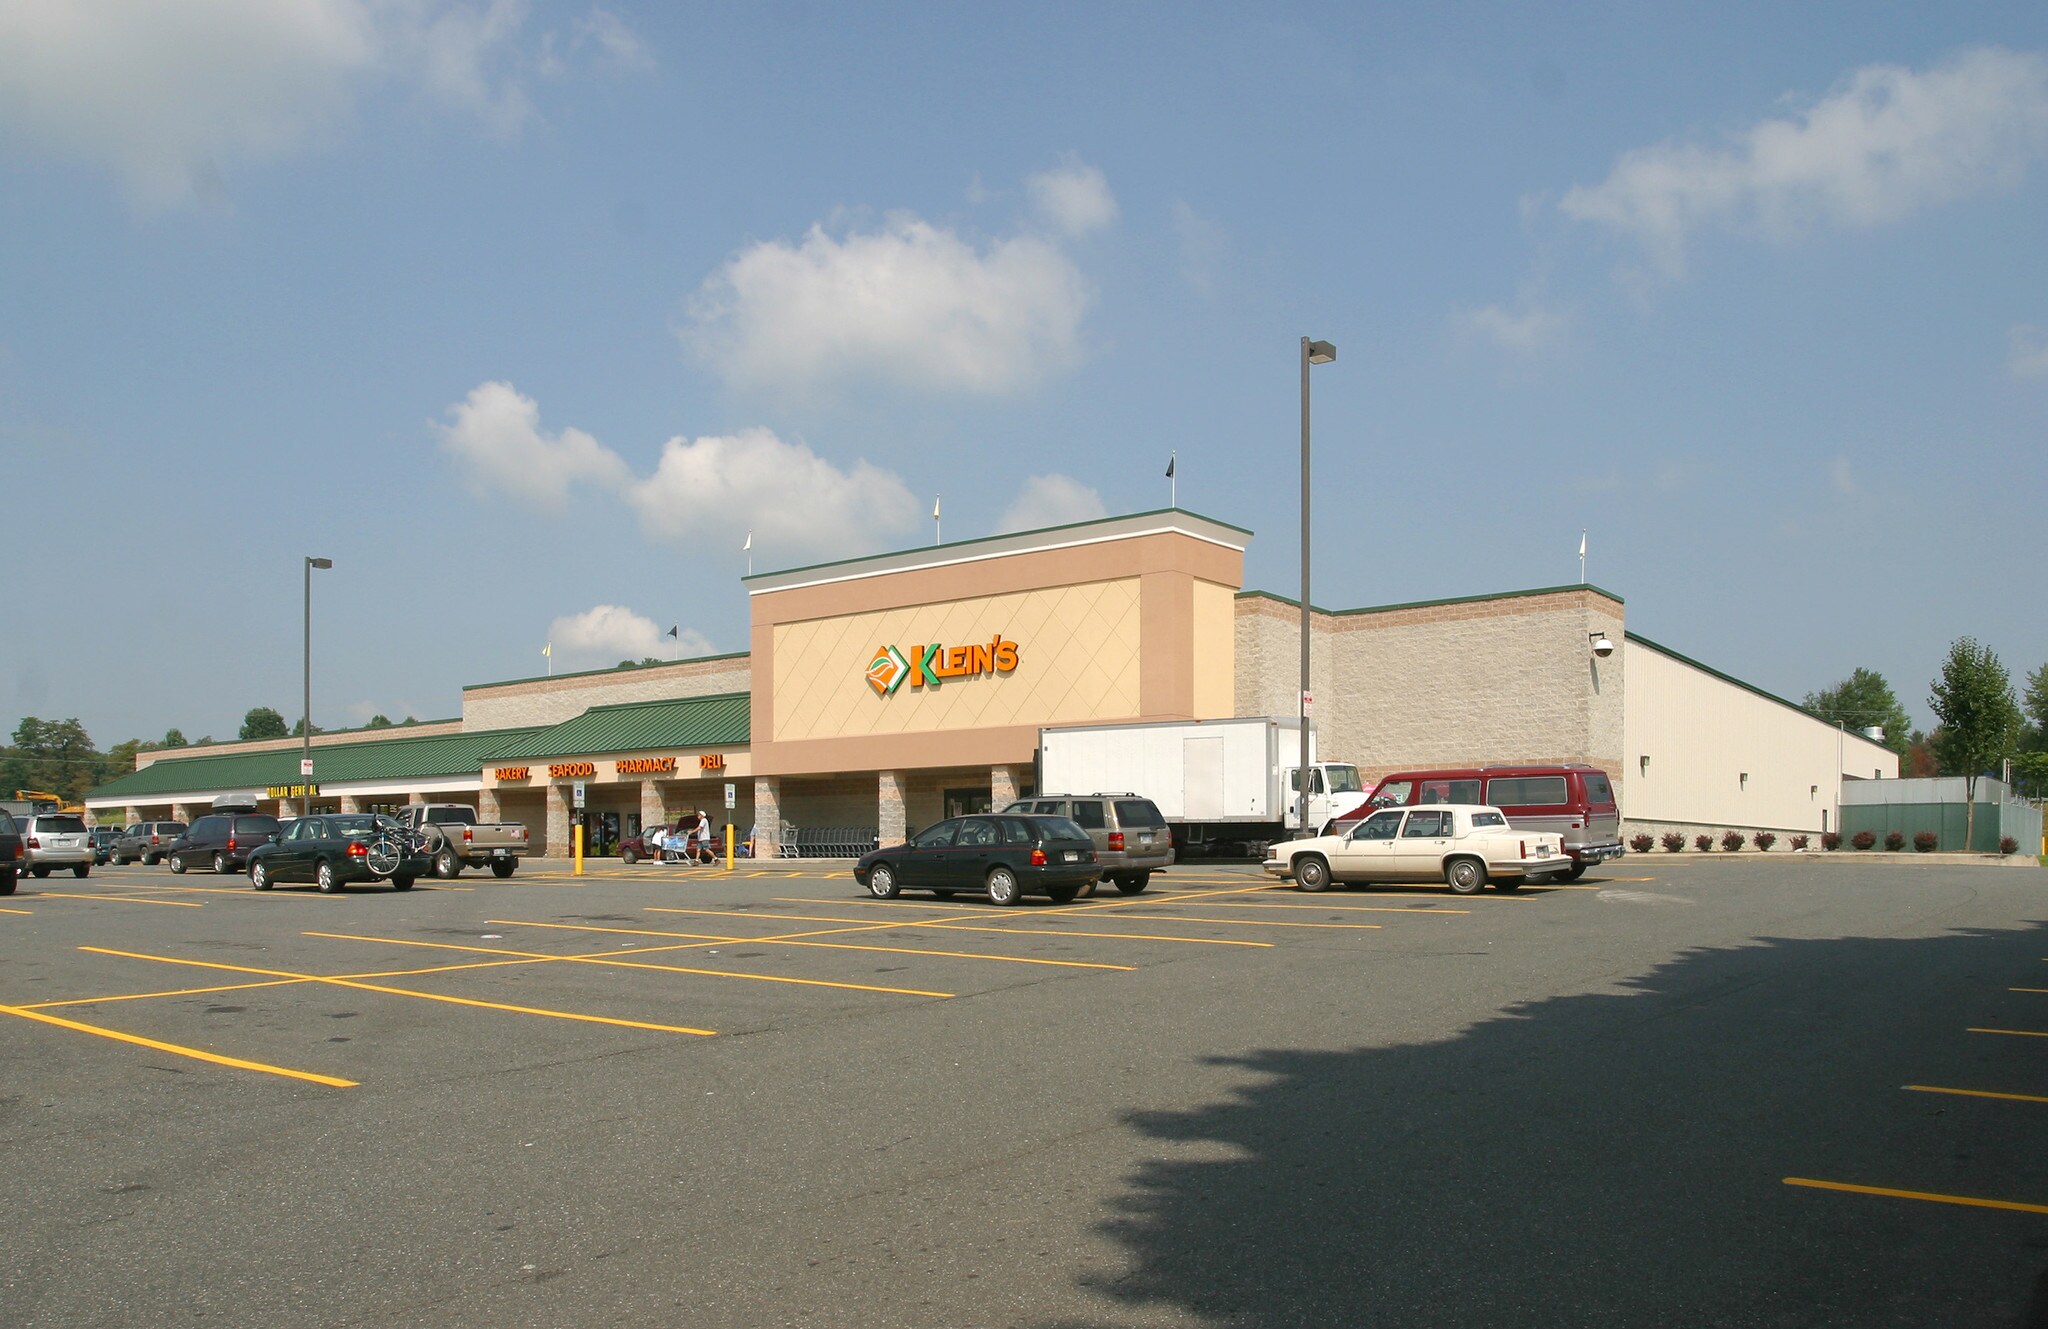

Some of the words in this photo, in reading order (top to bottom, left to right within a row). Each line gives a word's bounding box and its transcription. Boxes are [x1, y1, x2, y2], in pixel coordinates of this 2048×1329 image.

[910, 634, 1019, 687] KLEIN'S
[495, 766, 529, 780] BAKERY
[548, 762, 594, 777] SEAFOOD
[616, 757, 676, 774] PHARMACY
[700, 754, 723, 769] DELI
[266, 786, 289, 799] DOLLAR
[290, 784, 317, 798] GENEAL
